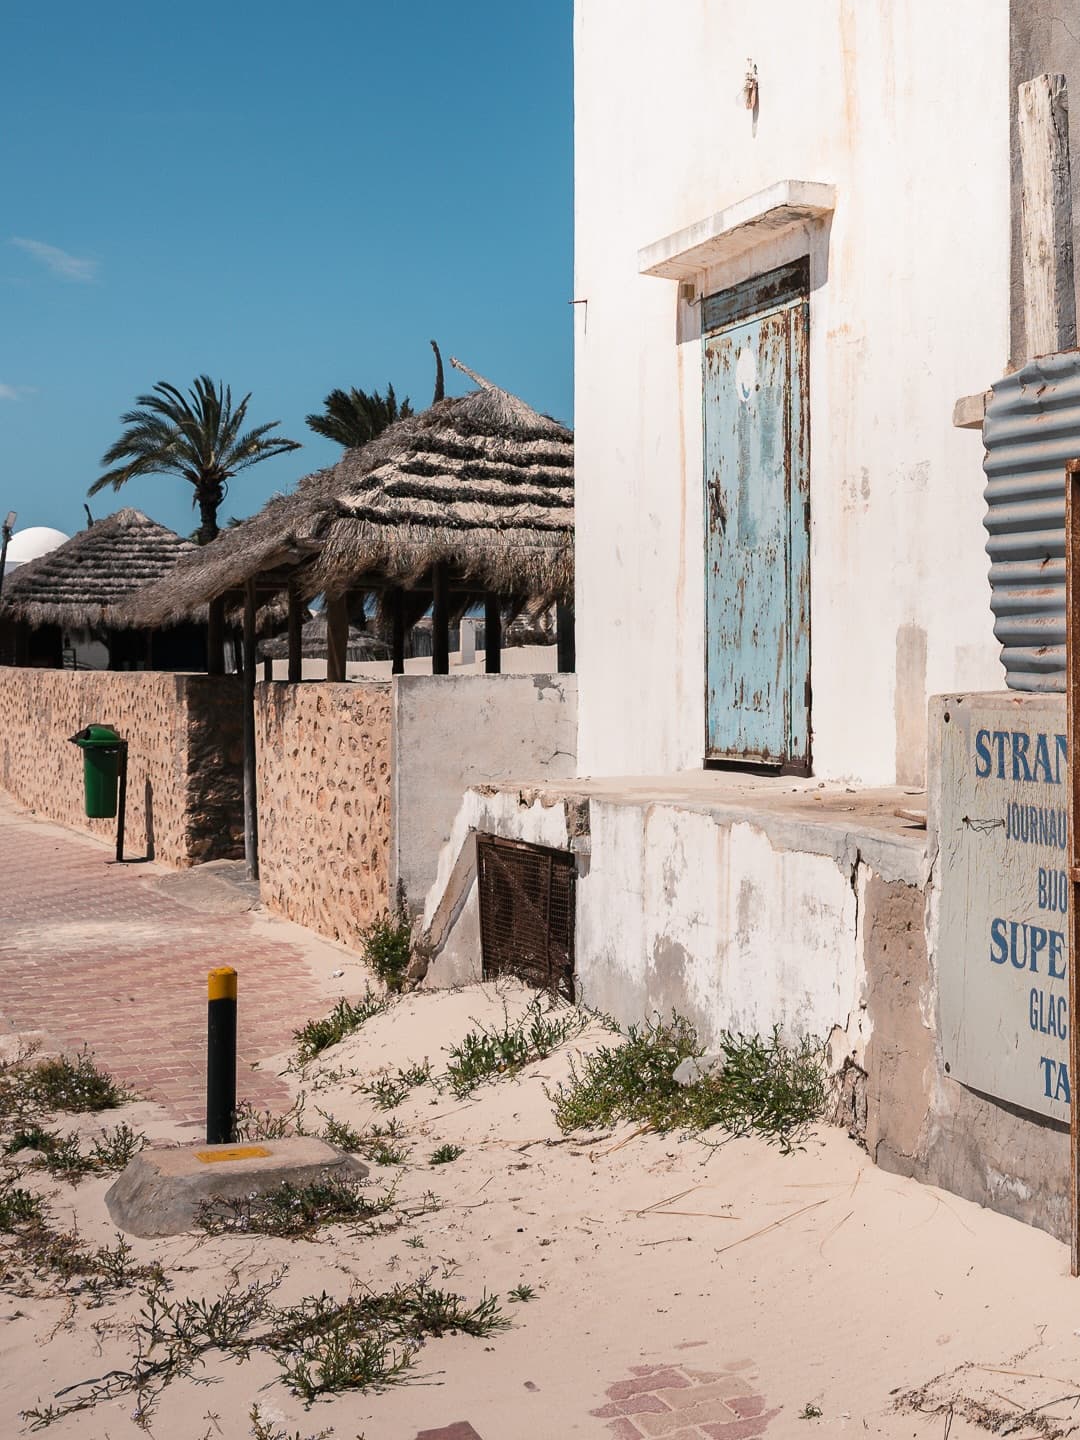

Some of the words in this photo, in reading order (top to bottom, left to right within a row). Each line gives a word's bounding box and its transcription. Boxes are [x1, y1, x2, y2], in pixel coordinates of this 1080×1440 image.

[975, 729, 1068, 784] STRAN
[1006, 802, 1067, 850] JOURNAU
[1038, 866, 1067, 914] BIJO
[1029, 987, 1067, 1040] GLAC
